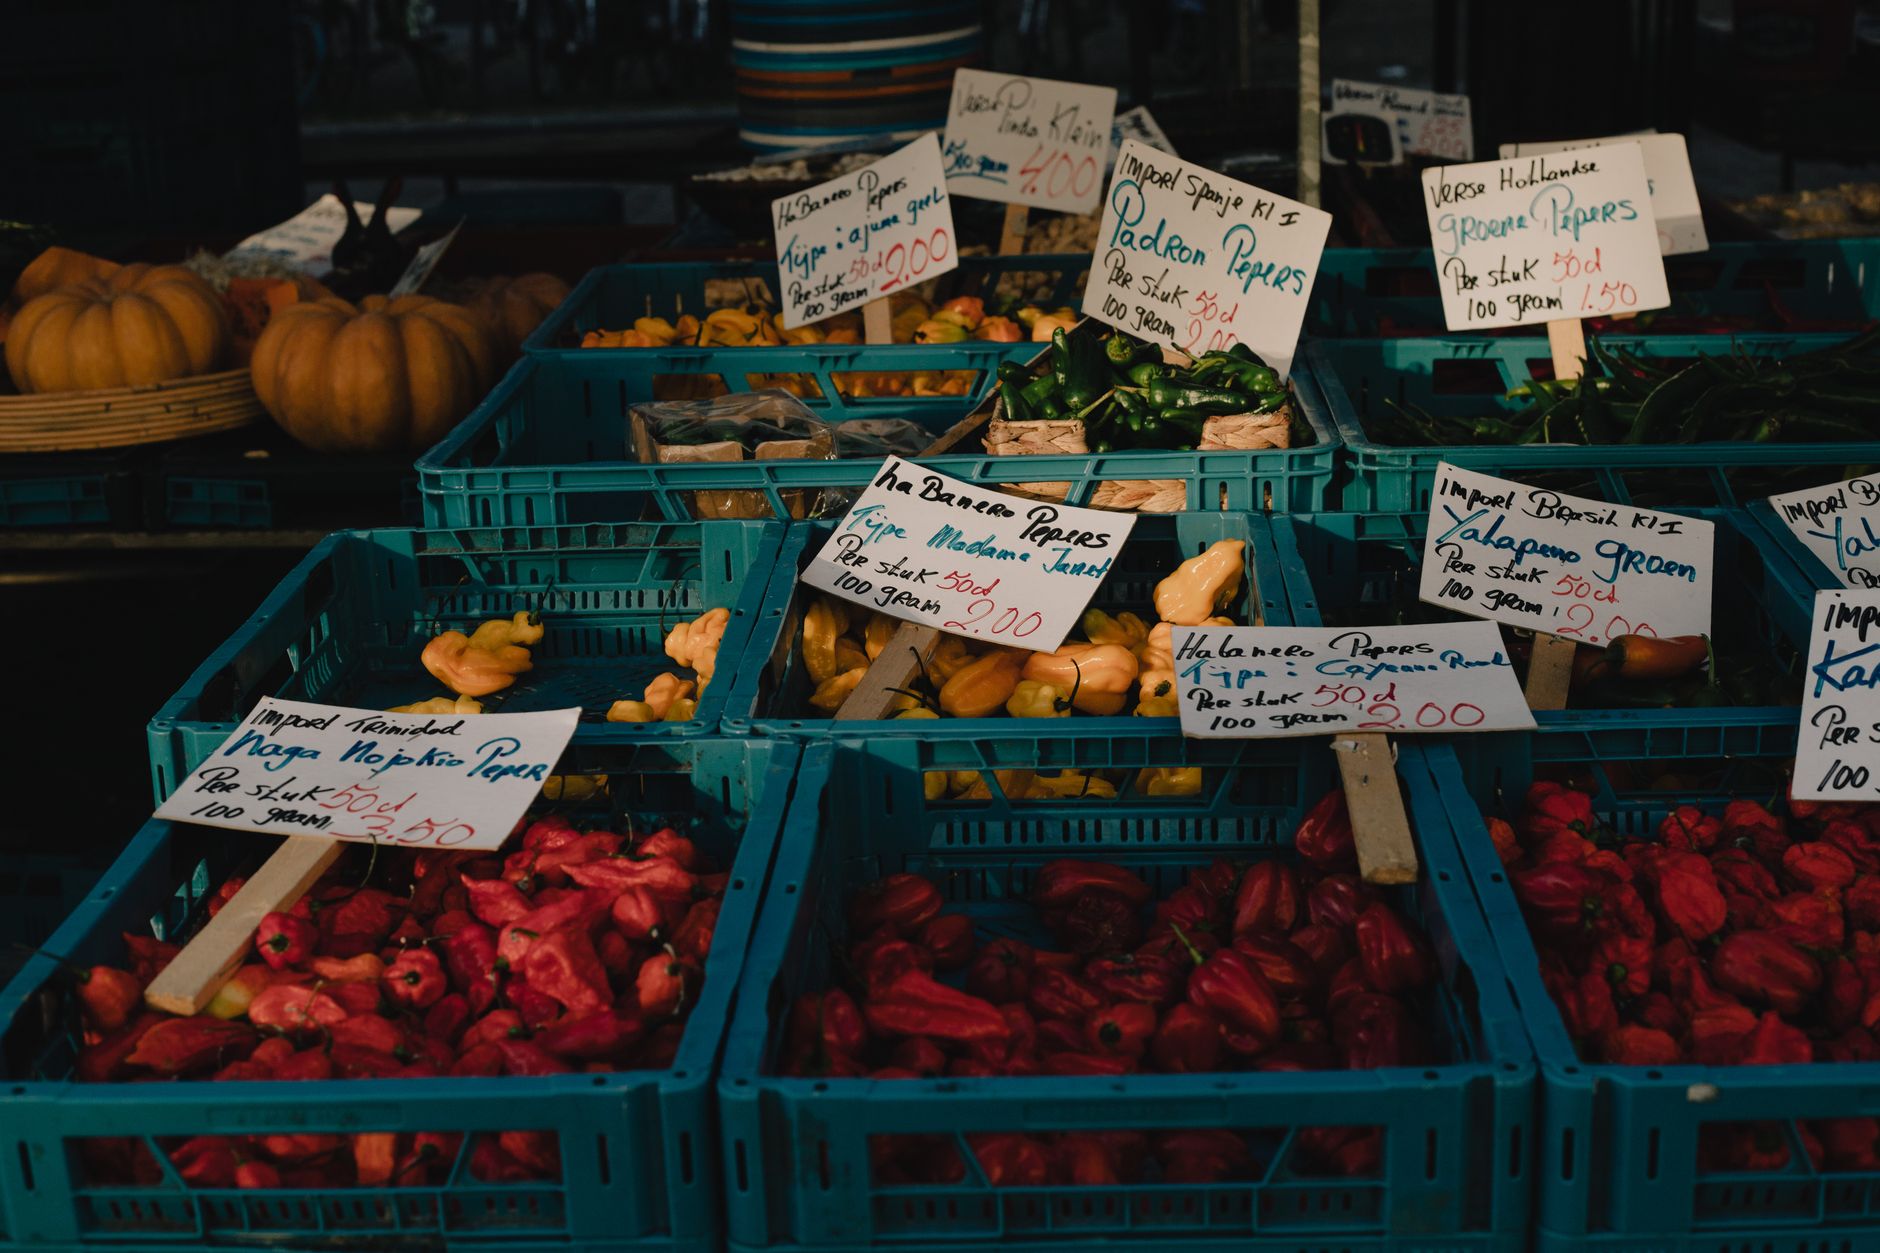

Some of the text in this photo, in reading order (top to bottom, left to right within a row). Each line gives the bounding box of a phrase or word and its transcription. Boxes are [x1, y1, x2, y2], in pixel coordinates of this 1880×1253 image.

[1049, 102, 1103, 148] Klein
[1019, 144, 1098, 198] 4.00
[906, 185, 946, 226] geel
[1184, 174, 1244, 218] Spanje
[1529, 183, 1639, 242] Pepers
[1110, 179, 1307, 296] Padron Pepers
[801, 301, 825, 322] 100
[879, 227, 950, 293] 2.00
[1104, 248, 1134, 290] Per
[1138, 269, 1189, 308] stuk
[1443, 256, 1480, 295] Per
[1488, 254, 1539, 288] stuk
[1101, 294, 1128, 321] 100
[1129, 306, 1176, 341] gram
[1468, 279, 1638, 322] 100 gram 1.50
[925, 523, 1032, 563] Madame
[1018, 505, 1112, 550] Pepers
[833, 533, 869, 568] Per
[874, 556, 939, 586] stuk
[1434, 542, 1475, 575] Per
[1484, 559, 1550, 584] stuk
[833, 570, 1042, 638] 100 gram 2.00
[1438, 577, 1474, 602] 100
[1480, 587, 1543, 617] gram
[1175, 631, 1435, 661] Habanero Pepers
[1186, 687, 1232, 712] Per
[1209, 702, 1486, 731] 100 gram 2.00
[344, 713, 466, 737] Trinidad
[1811, 704, 1861, 750] Per
[223, 729, 321, 772] Naga
[194, 766, 241, 794] Per
[244, 776, 336, 802] stuk
[1816, 758, 1871, 793] 100
[189, 801, 476, 847] 100 gram 3.50
